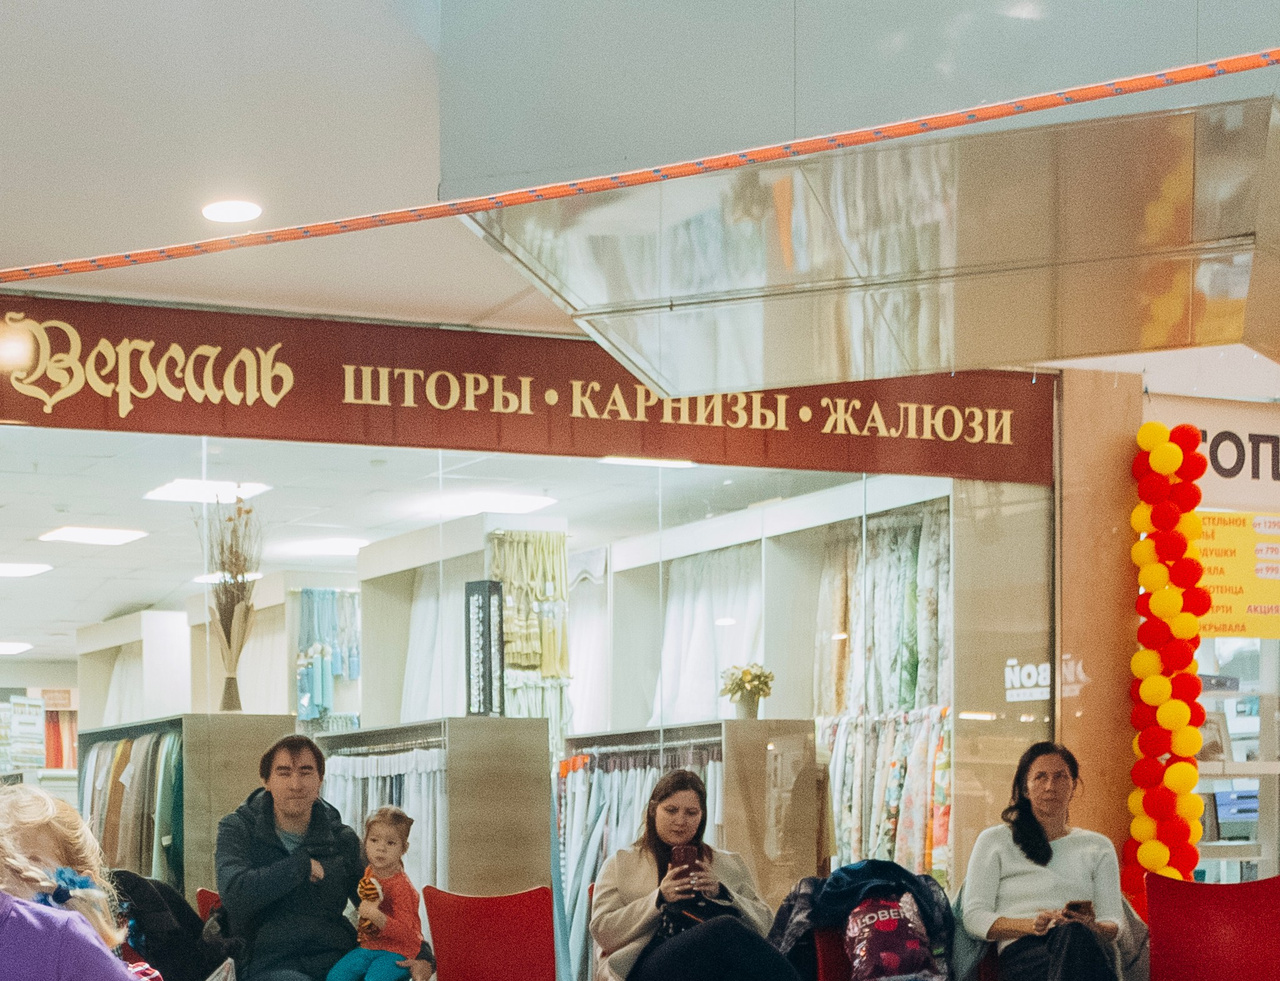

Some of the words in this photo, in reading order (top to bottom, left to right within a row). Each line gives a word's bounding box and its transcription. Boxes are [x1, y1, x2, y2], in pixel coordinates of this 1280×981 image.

[5, 311, 294, 418] Версаль
[342, 364, 535, 415] ШТОРЫ
[570, 379, 790, 431] КАРНИЗЫ
[820, 396, 1014, 445] ЖАЛЮЗИ
